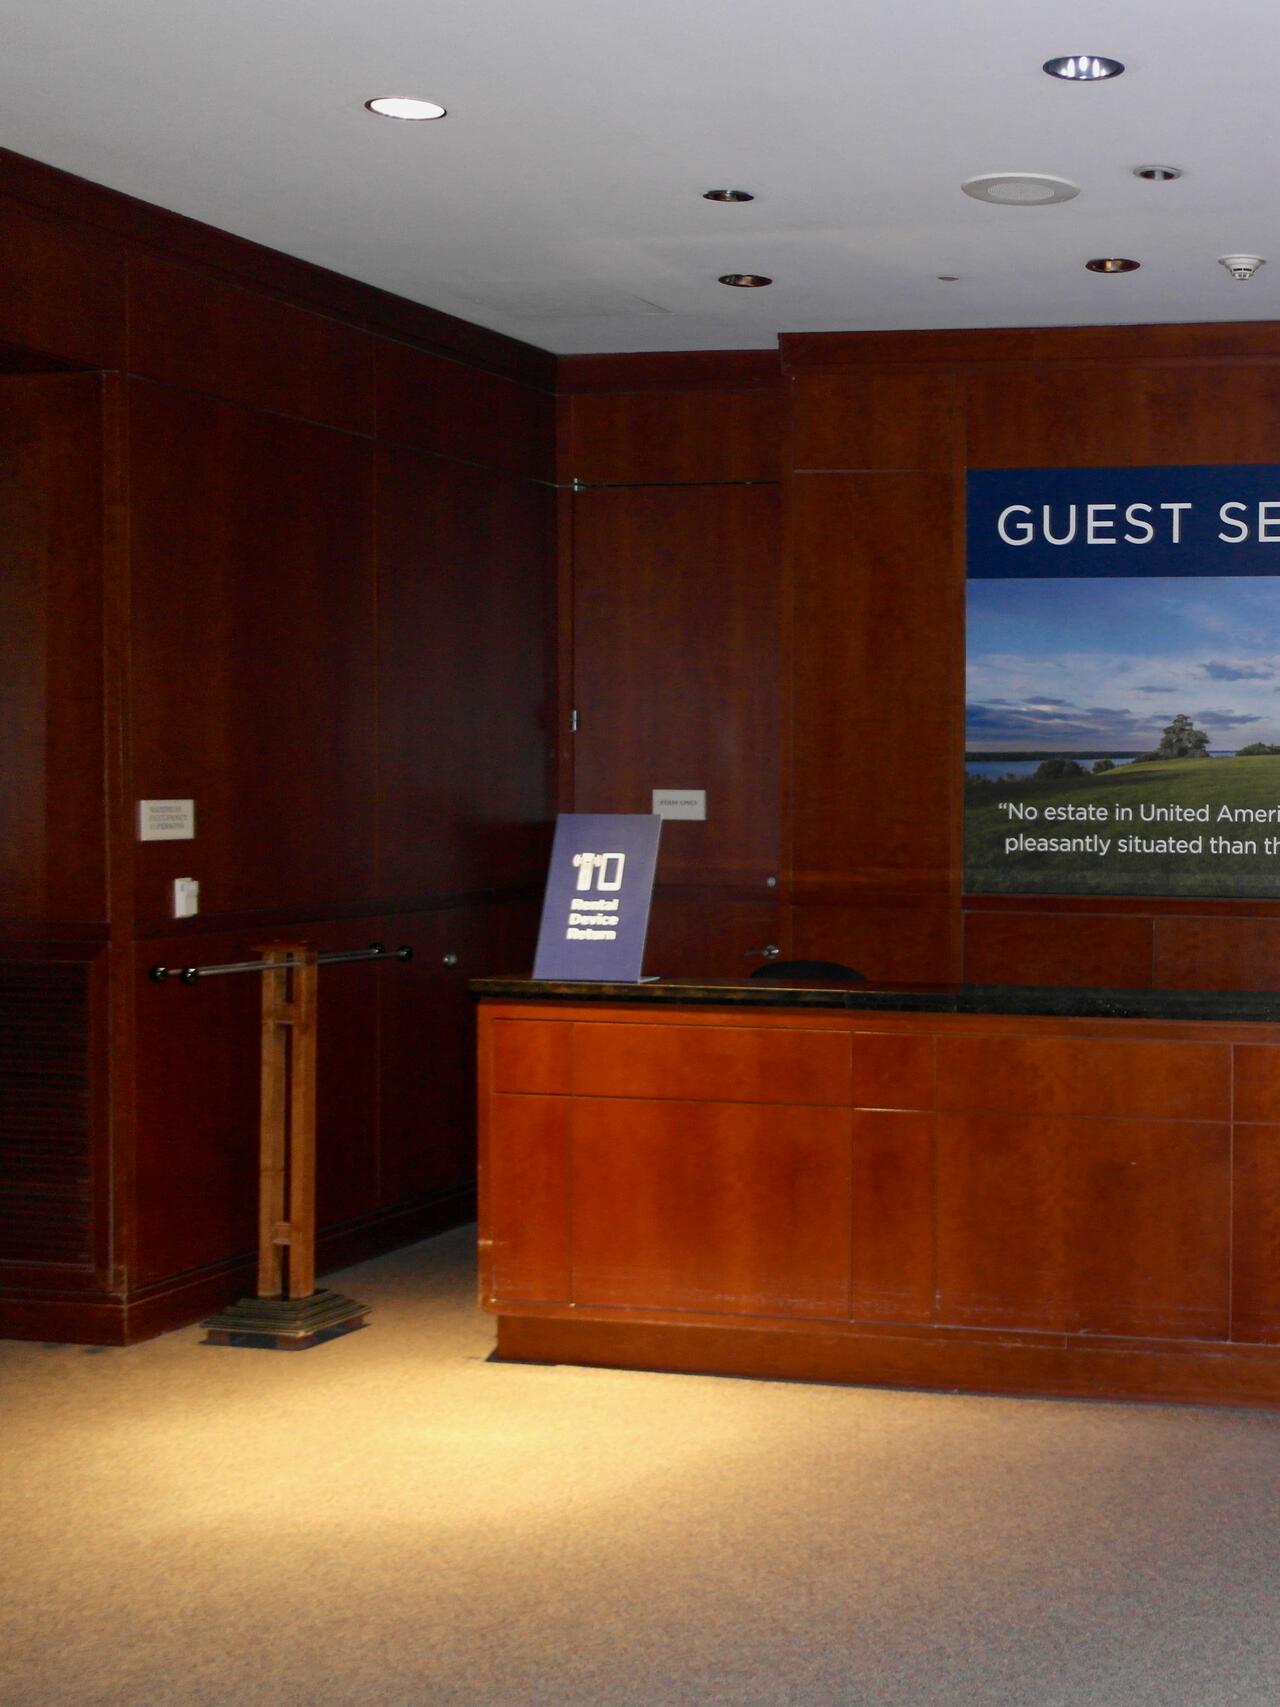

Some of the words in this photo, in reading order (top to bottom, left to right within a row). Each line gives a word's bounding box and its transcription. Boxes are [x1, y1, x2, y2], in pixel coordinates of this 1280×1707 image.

[997, 502, 1193, 546] GUEST
[1043, 803, 1109, 822] estate
[1115, 803, 1133, 822] in
[1140, 803, 1210, 823] United
[1004, 832, 1112, 857] pleasantly
[1117, 834, 1203, 854] situated
[1209, 835, 1257, 855] than
[568, 912, 619, 926] Device
[566, 927, 616, 940] Return
